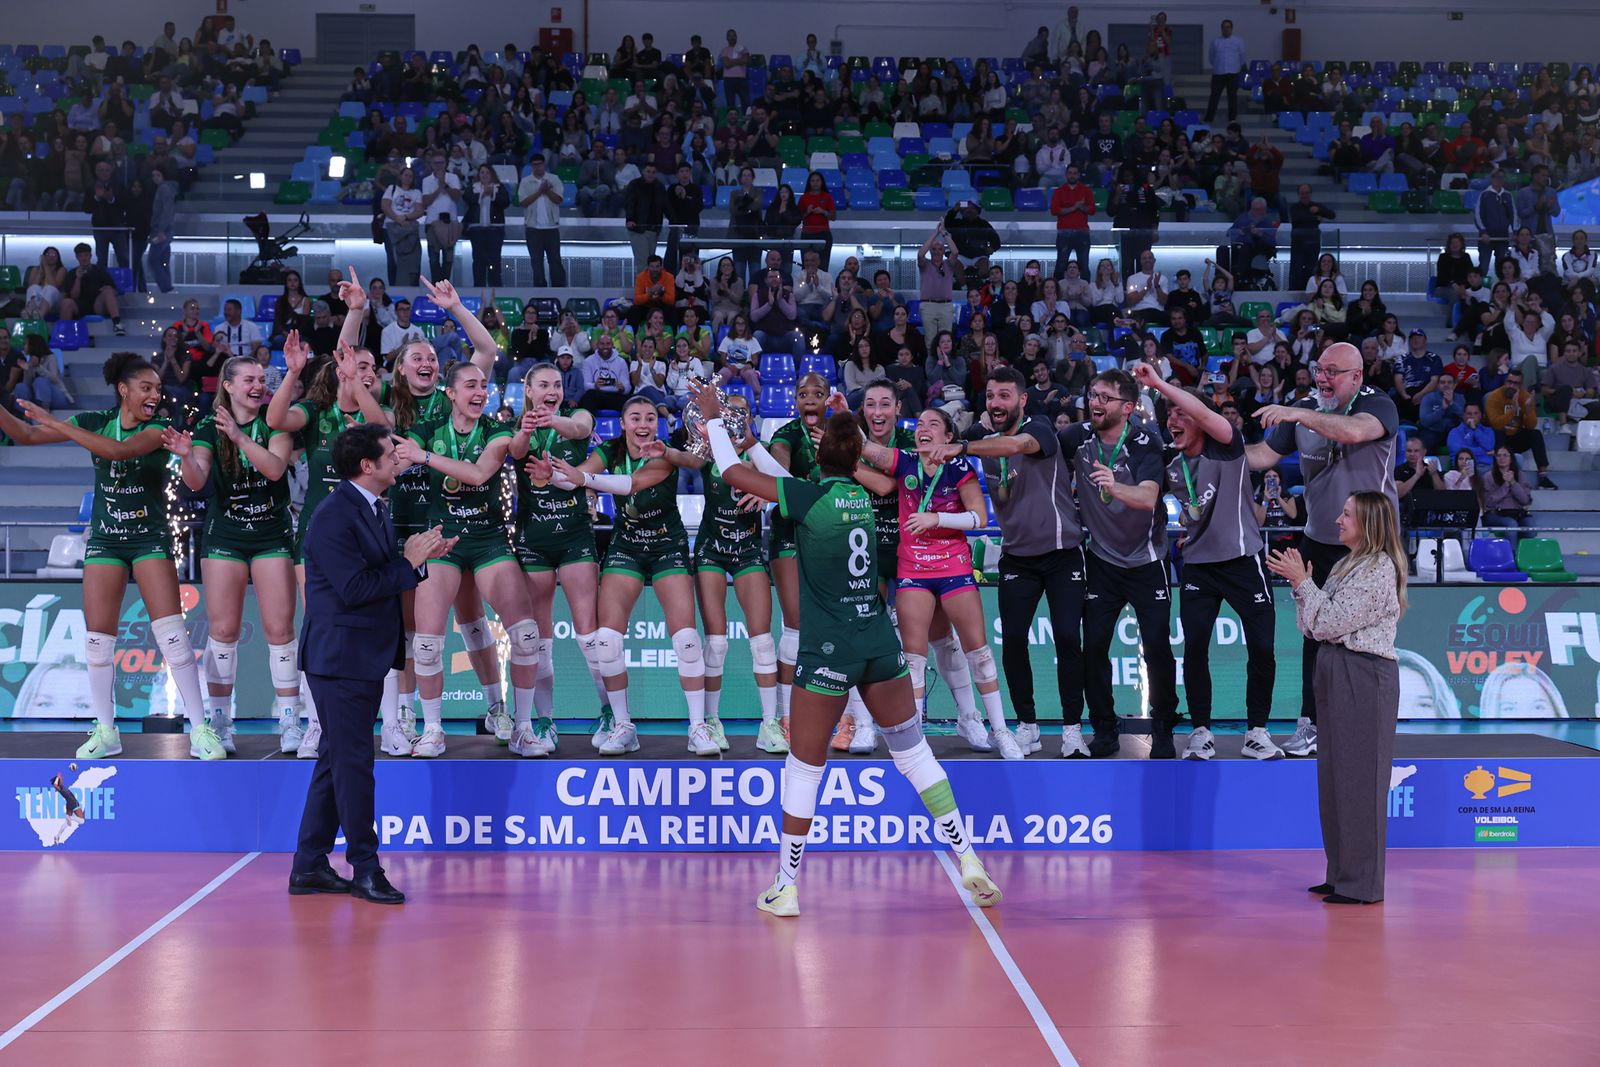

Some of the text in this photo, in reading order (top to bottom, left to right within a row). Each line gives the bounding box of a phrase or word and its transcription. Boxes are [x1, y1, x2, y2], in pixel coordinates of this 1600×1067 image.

[538, 496, 578, 512] Cajasol
[848, 527, 869, 577] 8
[634, 621, 666, 640] SM
[796, 665, 803, 677] 8
[556, 767, 885, 806] CAMPEOAS
[445, 815, 492, 845] DE
[505, 814, 586, 845] S.M.
[599, 815, 648, 844] LA
[660, 815, 781, 844] REINA
[1024, 814, 1113, 844] 2026
[1474, 816, 1519, 824] VOLEIBOL
